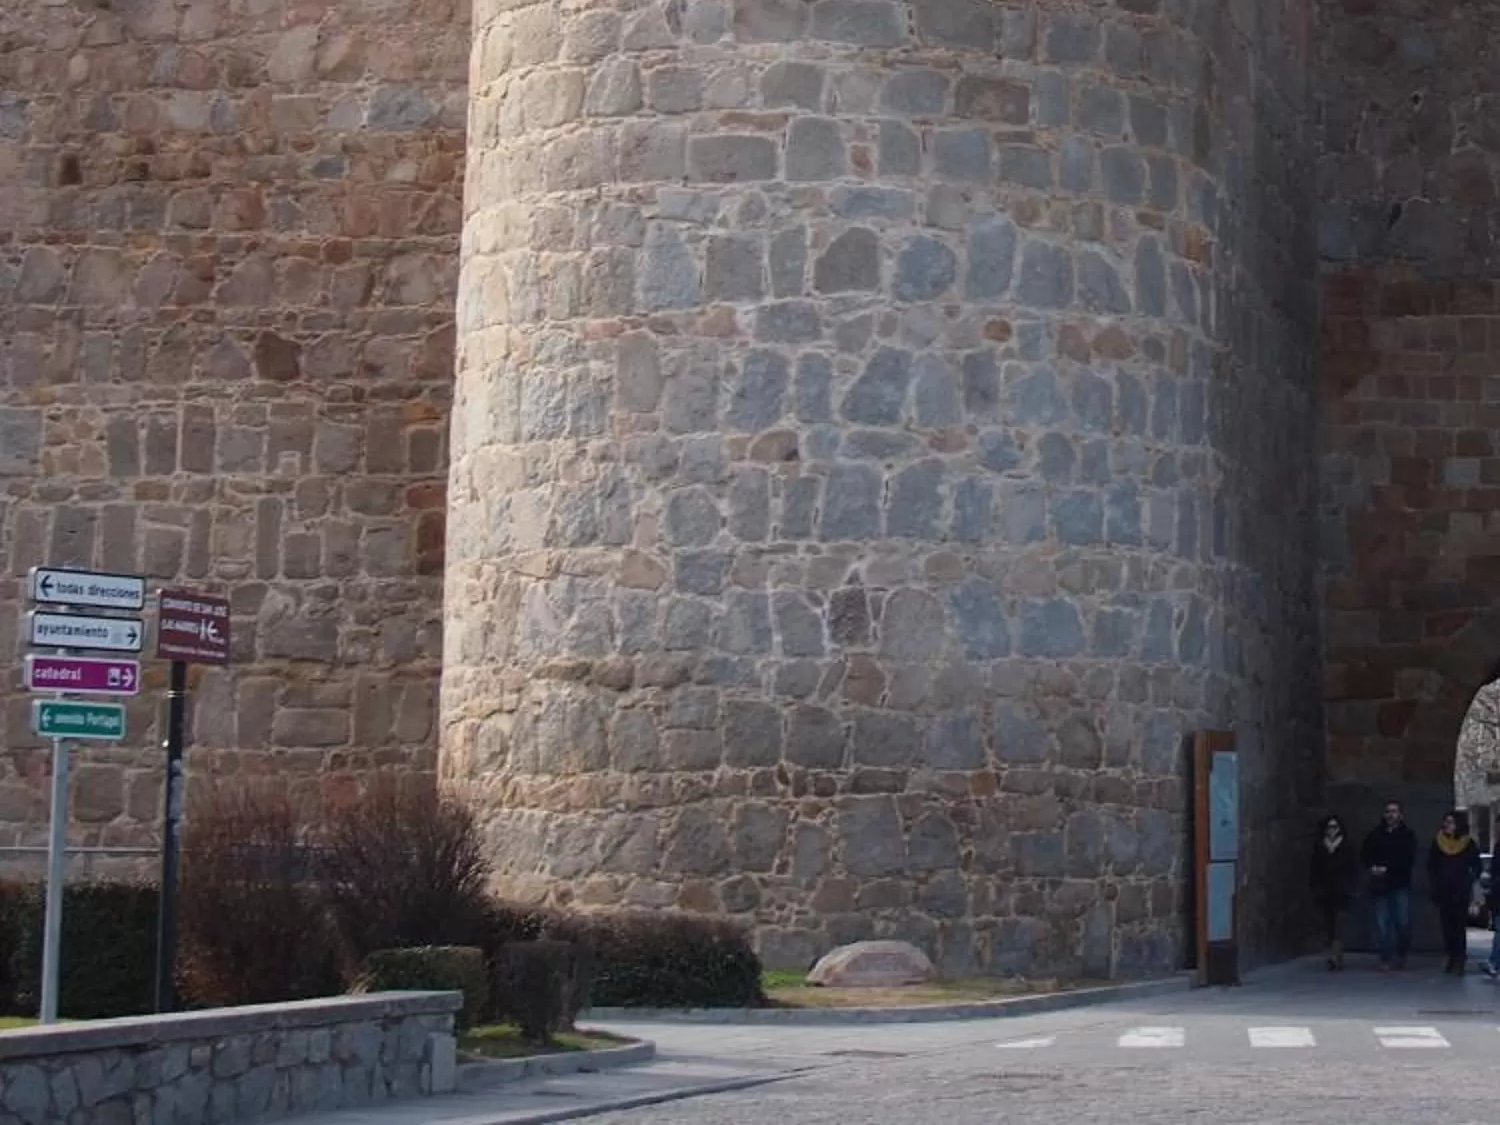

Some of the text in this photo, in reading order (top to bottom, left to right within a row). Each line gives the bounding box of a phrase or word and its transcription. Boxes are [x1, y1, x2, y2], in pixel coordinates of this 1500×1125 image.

[57, 582, 140, 599] todas direcciones
[37, 623, 108, 638] ayuntamiento
[35, 667, 81, 681] catedral
